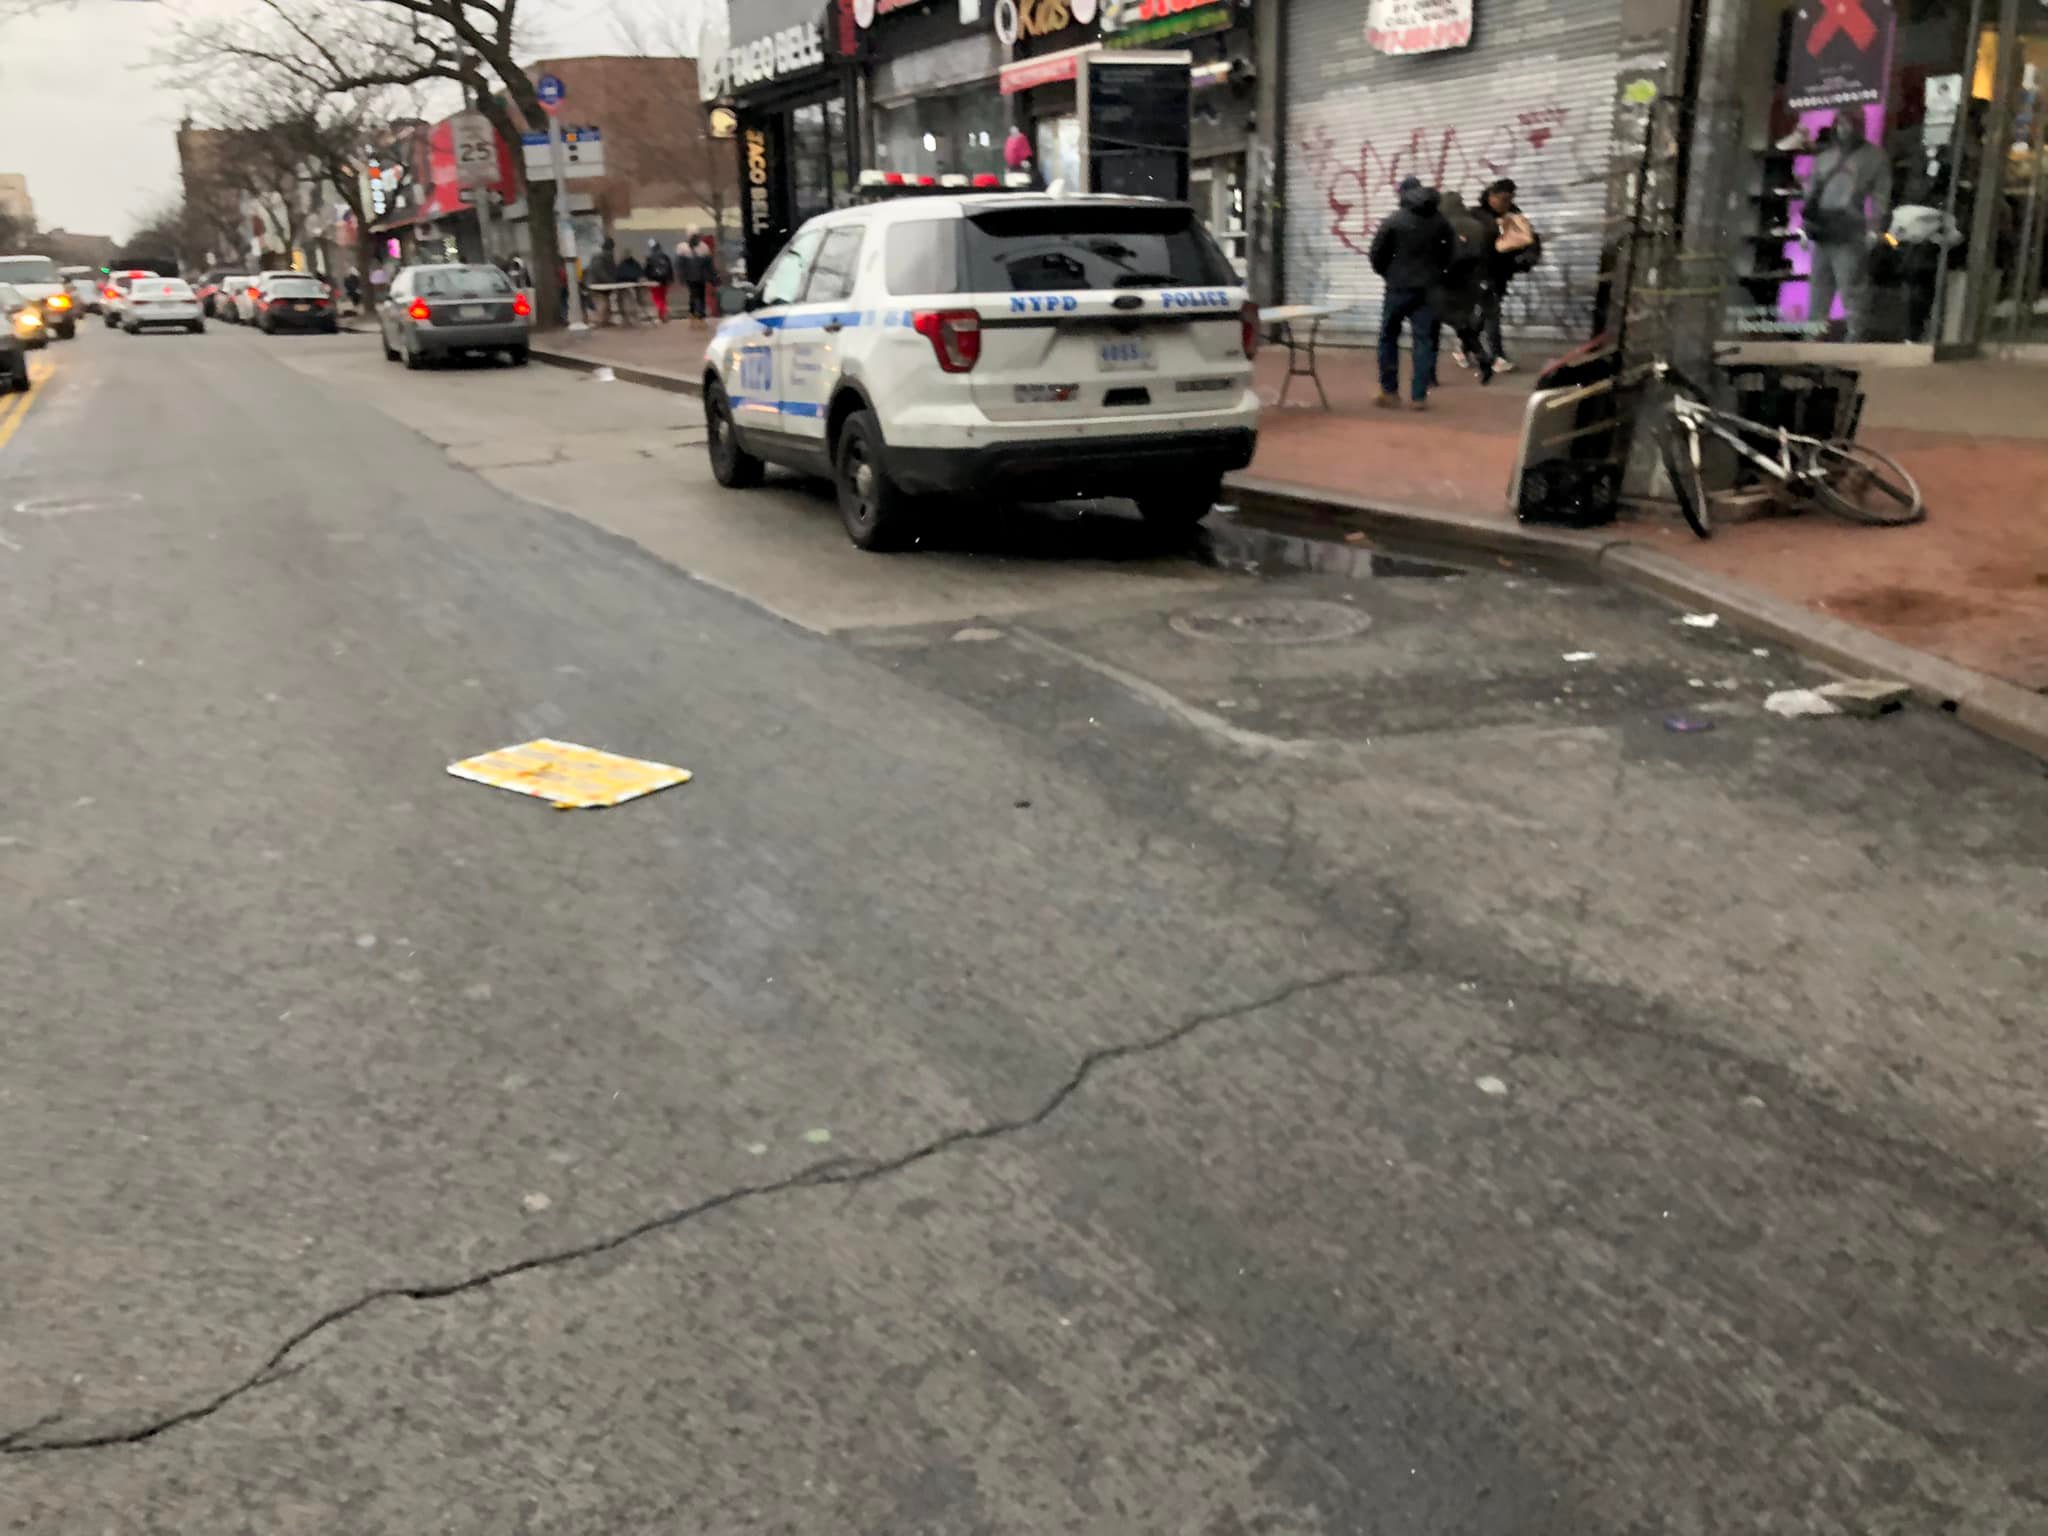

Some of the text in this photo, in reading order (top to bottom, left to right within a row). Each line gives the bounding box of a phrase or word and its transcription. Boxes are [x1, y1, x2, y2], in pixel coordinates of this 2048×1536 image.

[728, 36, 774, 87] TACO
[774, 22, 824, 73] BELL
[460, 142, 490, 162] 25
[745, 129, 769, 235] TACO BELL
[1010, 290, 1229, 312] NYPD POLICE
